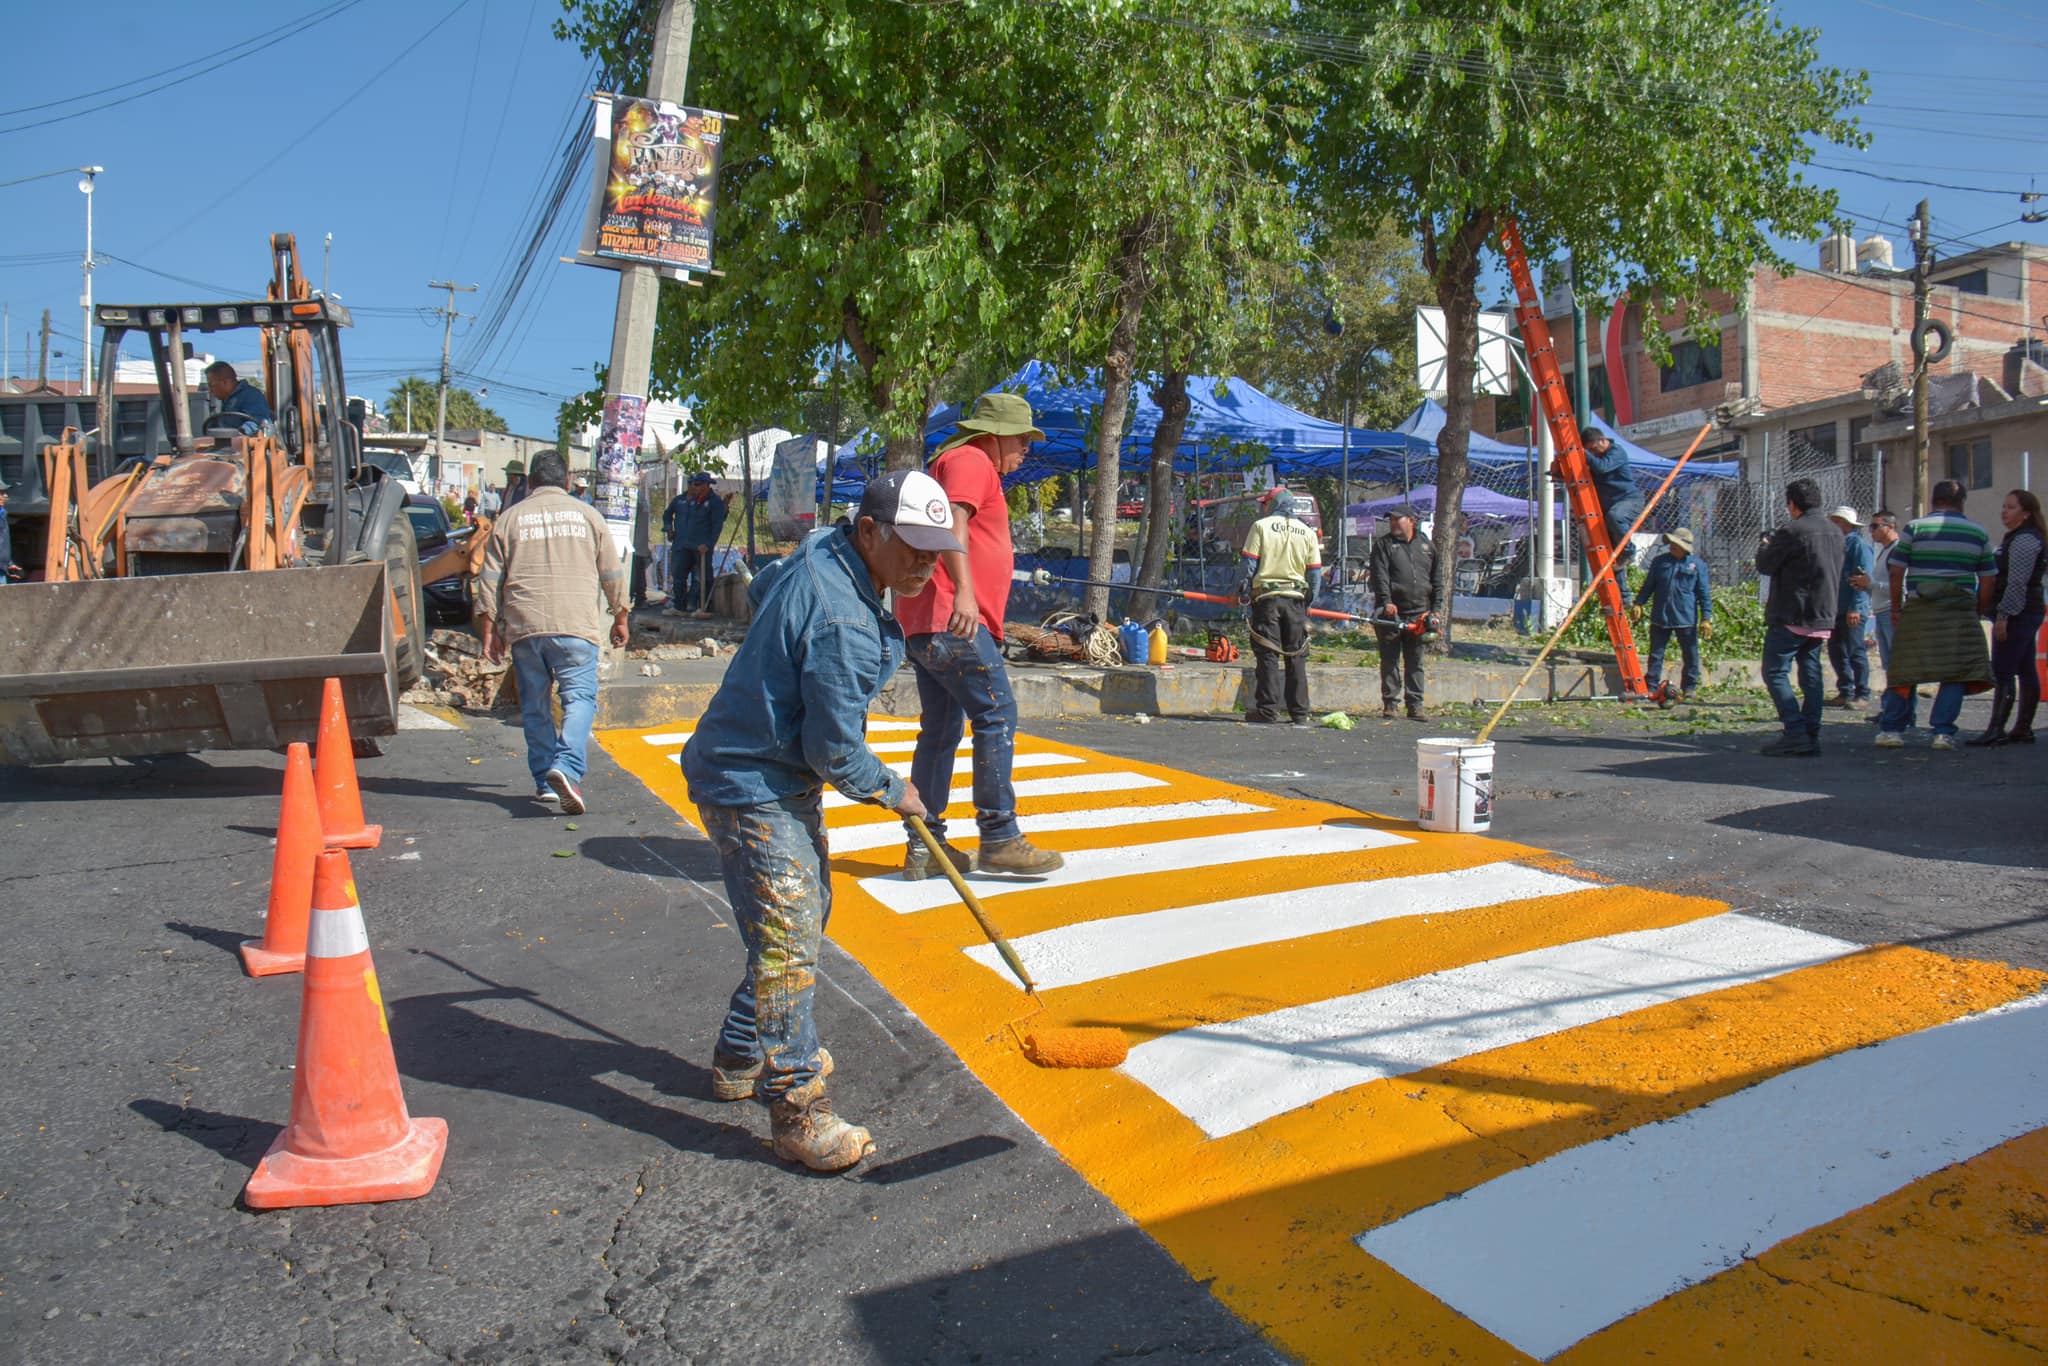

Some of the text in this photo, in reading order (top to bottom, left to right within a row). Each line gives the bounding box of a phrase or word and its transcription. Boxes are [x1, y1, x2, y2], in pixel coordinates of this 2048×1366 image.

[702, 115, 721, 134] 30
[642, 206, 654, 216] de
[656, 207, 683, 220] Nuevo
[648, 239, 659, 251] DE
[554, 511, 586, 524] GENERAL
[520, 528, 528, 542] DE
[1271, 522, 1306, 536] Corona
